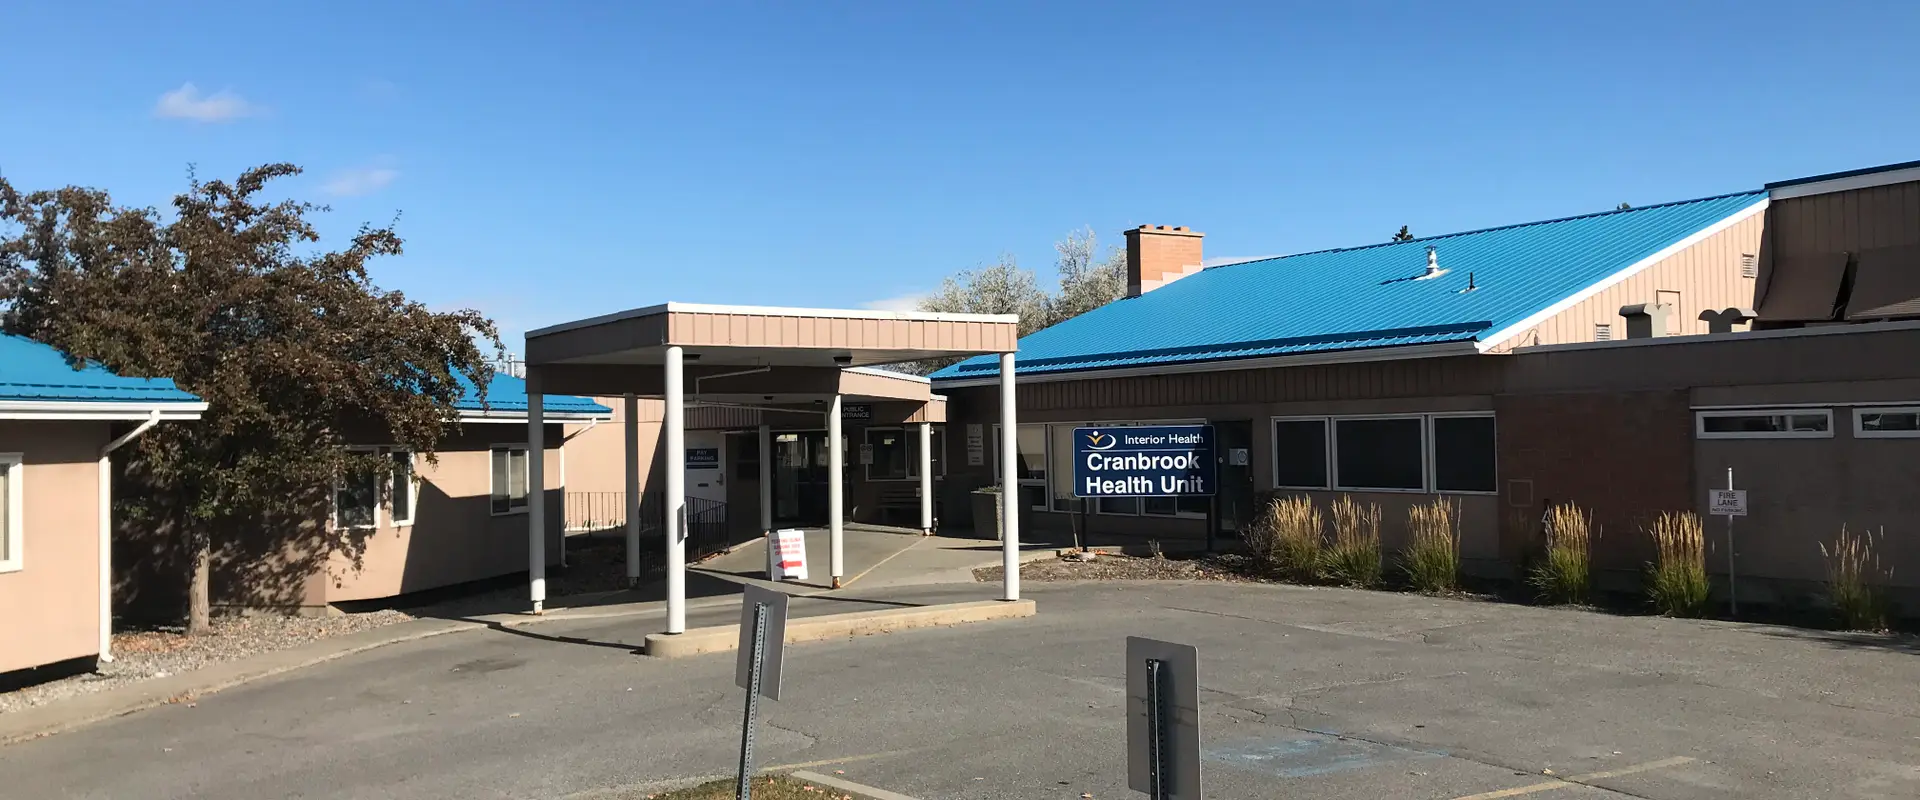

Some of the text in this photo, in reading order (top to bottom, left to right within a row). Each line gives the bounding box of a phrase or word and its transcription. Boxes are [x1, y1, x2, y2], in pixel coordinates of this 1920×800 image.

[1125, 433, 1203, 445] Interior Health
[1087, 452, 1200, 471] Cranbrook
[1086, 475, 1203, 494] Health Unit
